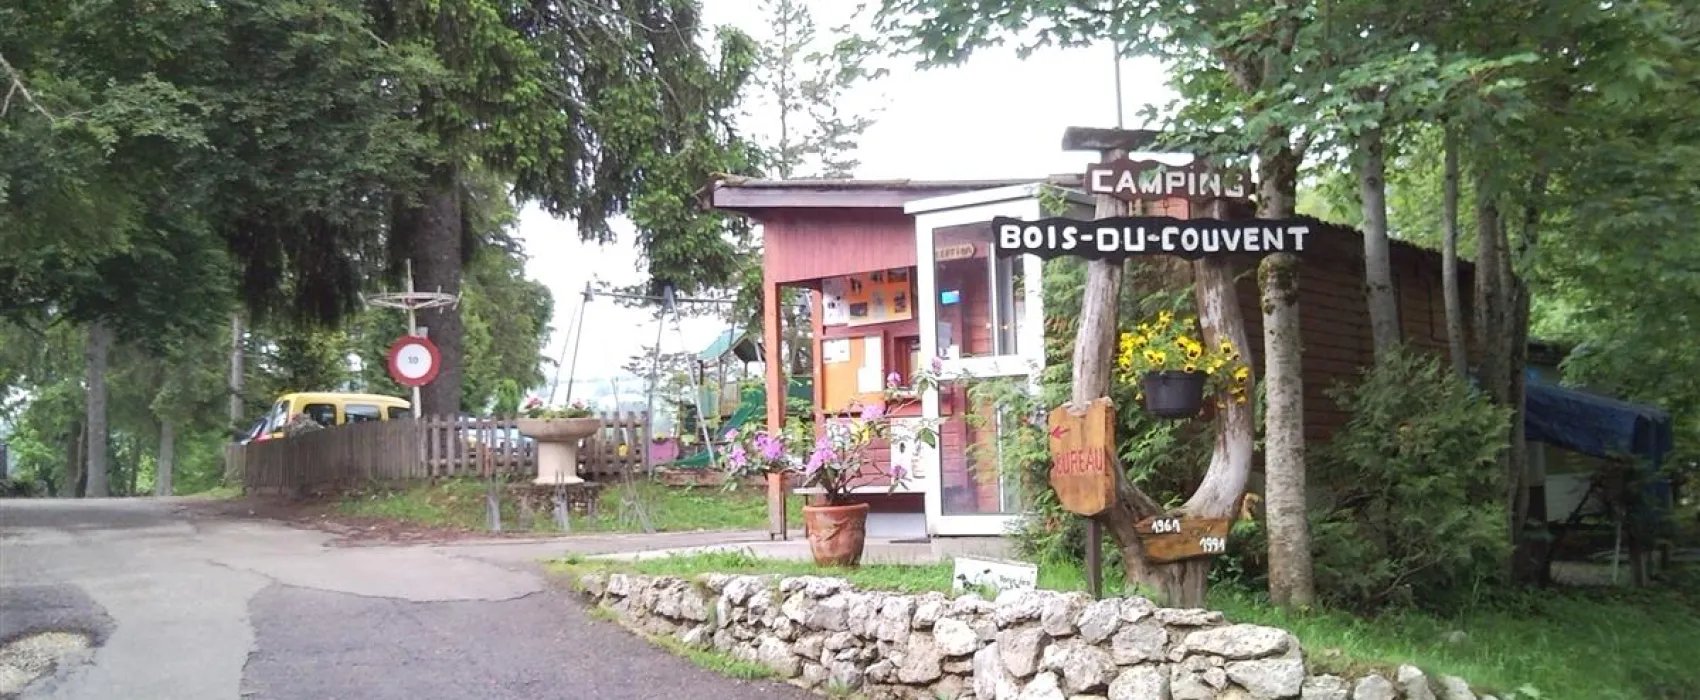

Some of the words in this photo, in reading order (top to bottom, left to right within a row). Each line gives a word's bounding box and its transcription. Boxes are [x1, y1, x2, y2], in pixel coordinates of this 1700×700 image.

[1091, 166, 1245, 198] CAMPING
[1000, 224, 1310, 252] BOIS-DU-COUVENT
[1056, 447, 1104, 475] BUREAU
[1199, 536, 1225, 553] 1991
